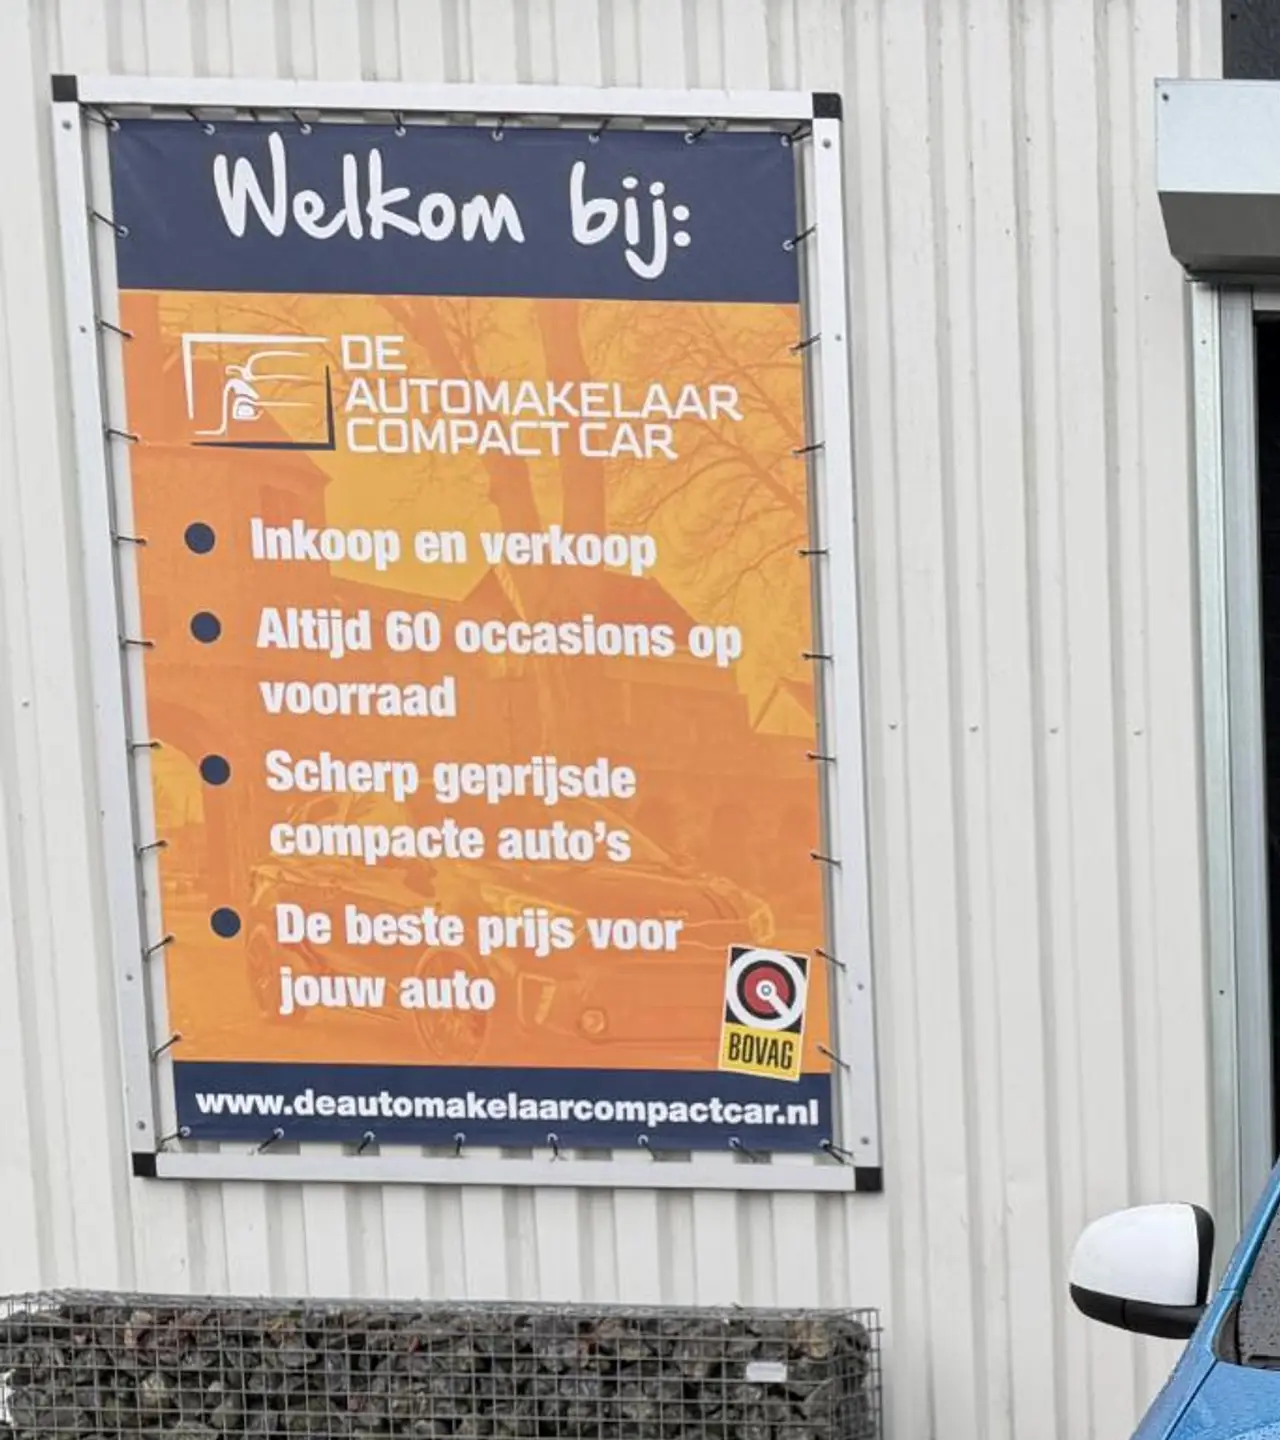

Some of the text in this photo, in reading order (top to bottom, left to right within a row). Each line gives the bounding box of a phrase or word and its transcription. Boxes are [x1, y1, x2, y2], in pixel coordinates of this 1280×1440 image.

[214, 132, 690, 278] Welkom bij:
[341, 335, 406, 370] DE
[345, 378, 743, 420] AUTOMAKELAAR
[347, 418, 677, 459] COMPACT CAR
[251, 518, 656, 576] Inkoop en verkoop
[257, 608, 741, 667] Altijd 60 occasions op
[260, 677, 455, 716] voorraad
[266, 750, 636, 805] Scherp geprijsde
[270, 820, 484, 865] compacte
[276, 904, 683, 957] De beste prijs voor
[280, 967, 495, 1014] jouw auto
[728, 1031, 794, 1071] BOVAG
[196, 1089, 818, 1127] www.deautomakelaarcompactcar.nl
